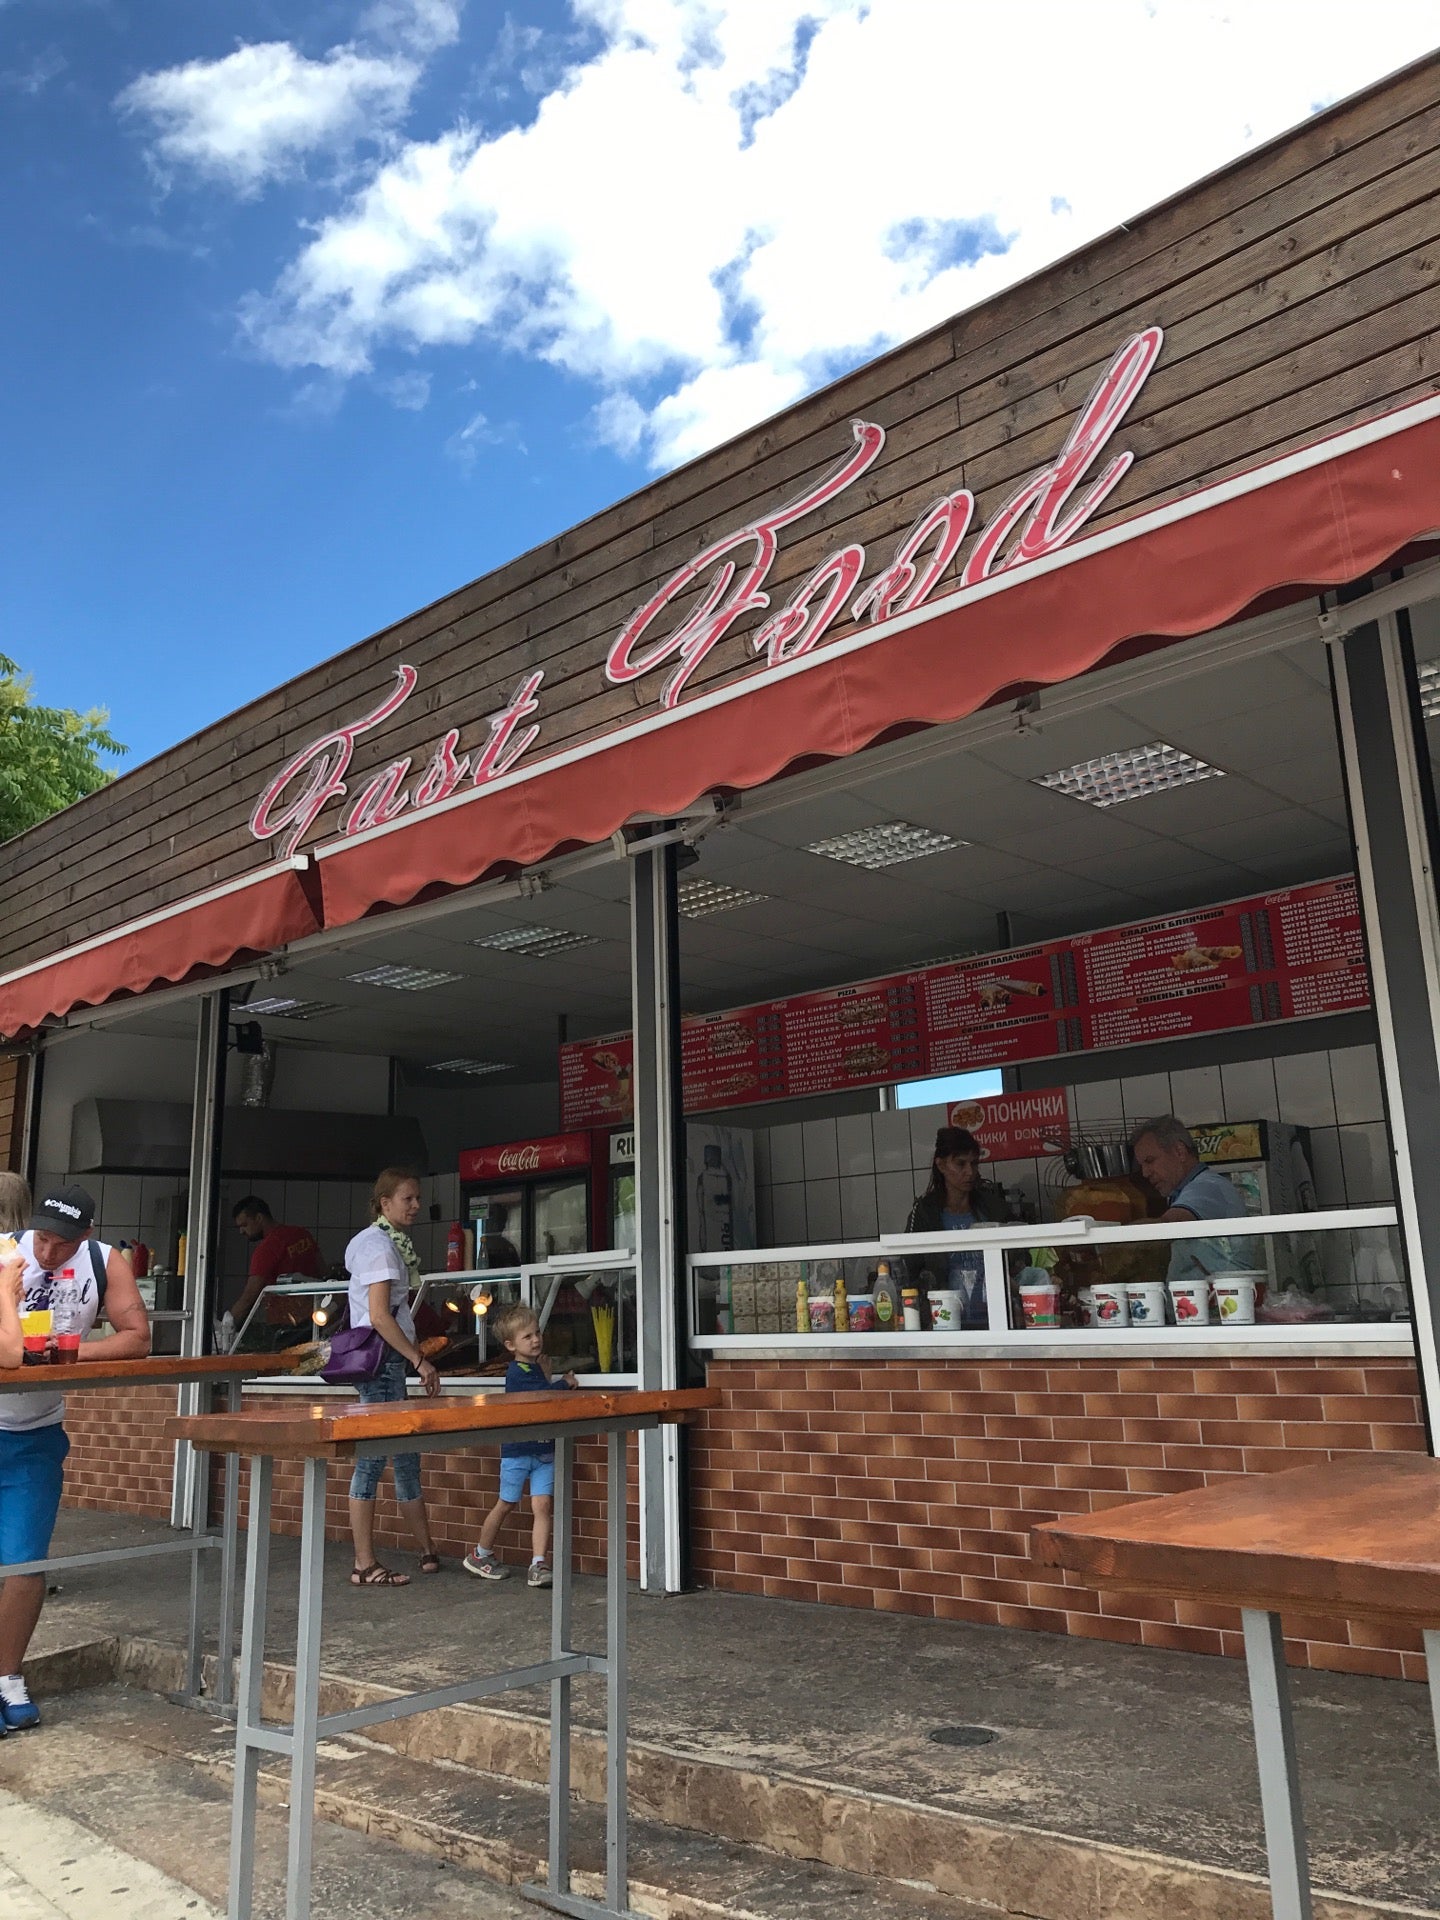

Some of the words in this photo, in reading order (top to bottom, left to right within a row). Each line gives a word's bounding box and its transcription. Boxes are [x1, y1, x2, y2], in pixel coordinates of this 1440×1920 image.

[249, 664, 544, 860] Fast
[605, 325, 1165, 707] Food
[1280, 902, 1304, 911] WITH
[1281, 908, 1305, 917] WITH
[1282, 914, 1306, 924] WITH
[1282, 920, 1307, 930] WITH
[1284, 927, 1308, 936] WITH
[1284, 933, 1309, 942] WITH
[1311, 927, 1341, 937] HONEY
[1285, 939, 1310, 948] WITH
[1312, 933, 1342, 943] HONEY
[1286, 945, 1310, 954] WITH
[1287, 952, 1311, 961] WITH
[1288, 958, 1312, 967] WITH
[1314, 952, 1345, 962] LEMON
[1290, 975, 1315, 984] WITH
[1317, 969, 1351, 979] CHEESE
[1291, 982, 1316, 990] WITH
[1318, 975, 1354, 985] YELLOW
[838, 988, 857, 997] PIZZA
[1292, 988, 1316, 996] WITH
[1292, 994, 1317, 1003] WITH
[1320, 990, 1341, 998] HAM
[785, 1010, 805, 1019] WITH
[808, 1003, 838, 1014] CHEESE
[841, 1000, 858, 1008] AND
[860, 995, 880, 1004] HAM
[1294, 1001, 1318, 1009] WITH
[785, 1018, 806, 1027] WITH
[786, 1032, 807, 1040] WITH
[809, 1025, 840, 1036] CHEESE
[863, 1017, 886, 1026] CORN
[787, 1040, 807, 1048] WITH
[810, 1034, 841, 1044] YELLOW
[844, 1027, 877, 1038] CHEESE
[806, 1040, 836, 1050] SALAMI
[788, 1053, 808, 1062] WITH
[810, 1047, 842, 1058] YELLOW
[845, 1041, 878, 1052] CHEESE
[806, 1053, 842, 1064] CHICKEN
[788, 1067, 809, 1075] WITH
[807, 1068, 835, 1077] OLIVES
[789, 1083, 832, 1094] PINEAPPLE
[987, 1095, 1064, 1124] ПОНИЧКИ
[974, 1131, 1007, 1145] ЧИКИ
